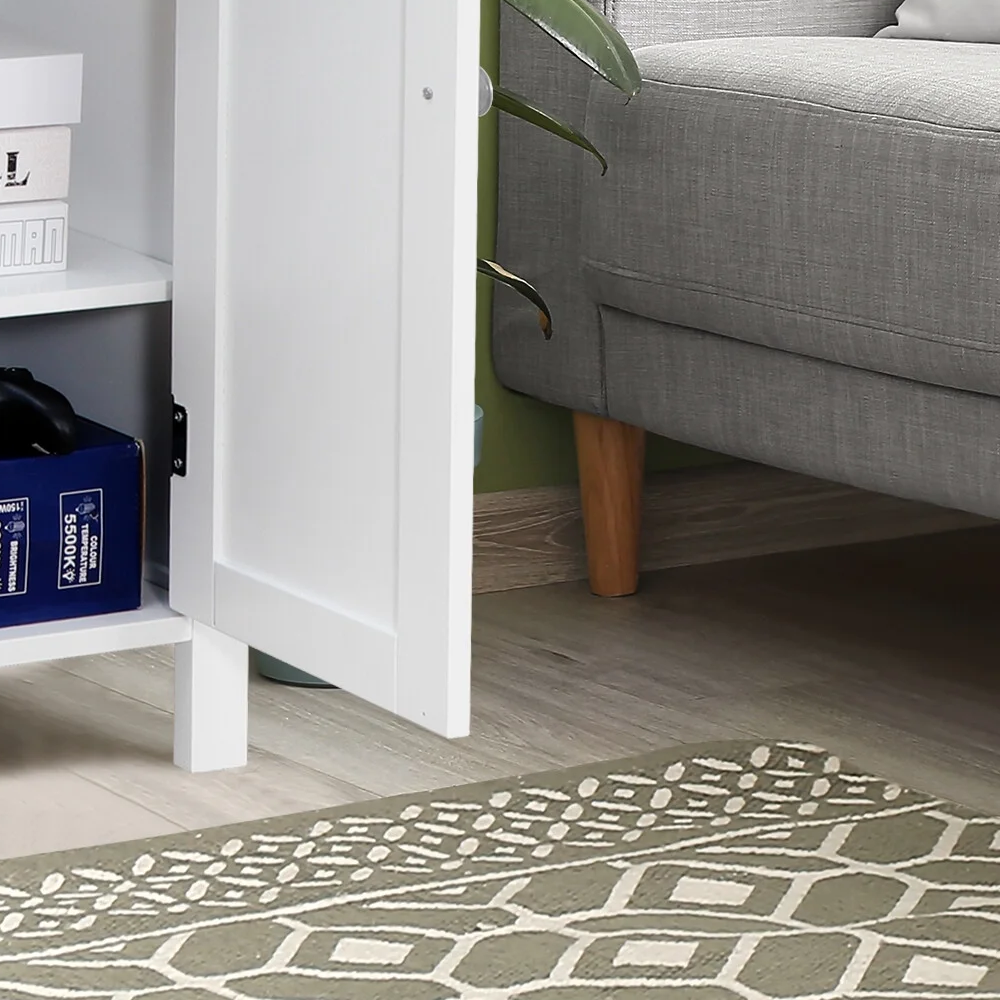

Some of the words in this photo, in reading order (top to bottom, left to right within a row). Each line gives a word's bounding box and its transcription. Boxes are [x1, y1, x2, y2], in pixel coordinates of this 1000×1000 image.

[7, 540, 19, 592] BRIGHTNESS
[63, 514, 78, 569] 5500K
[78, 523, 90, 583] TEMPERATURE
[88, 535, 99, 570] COLOUR
